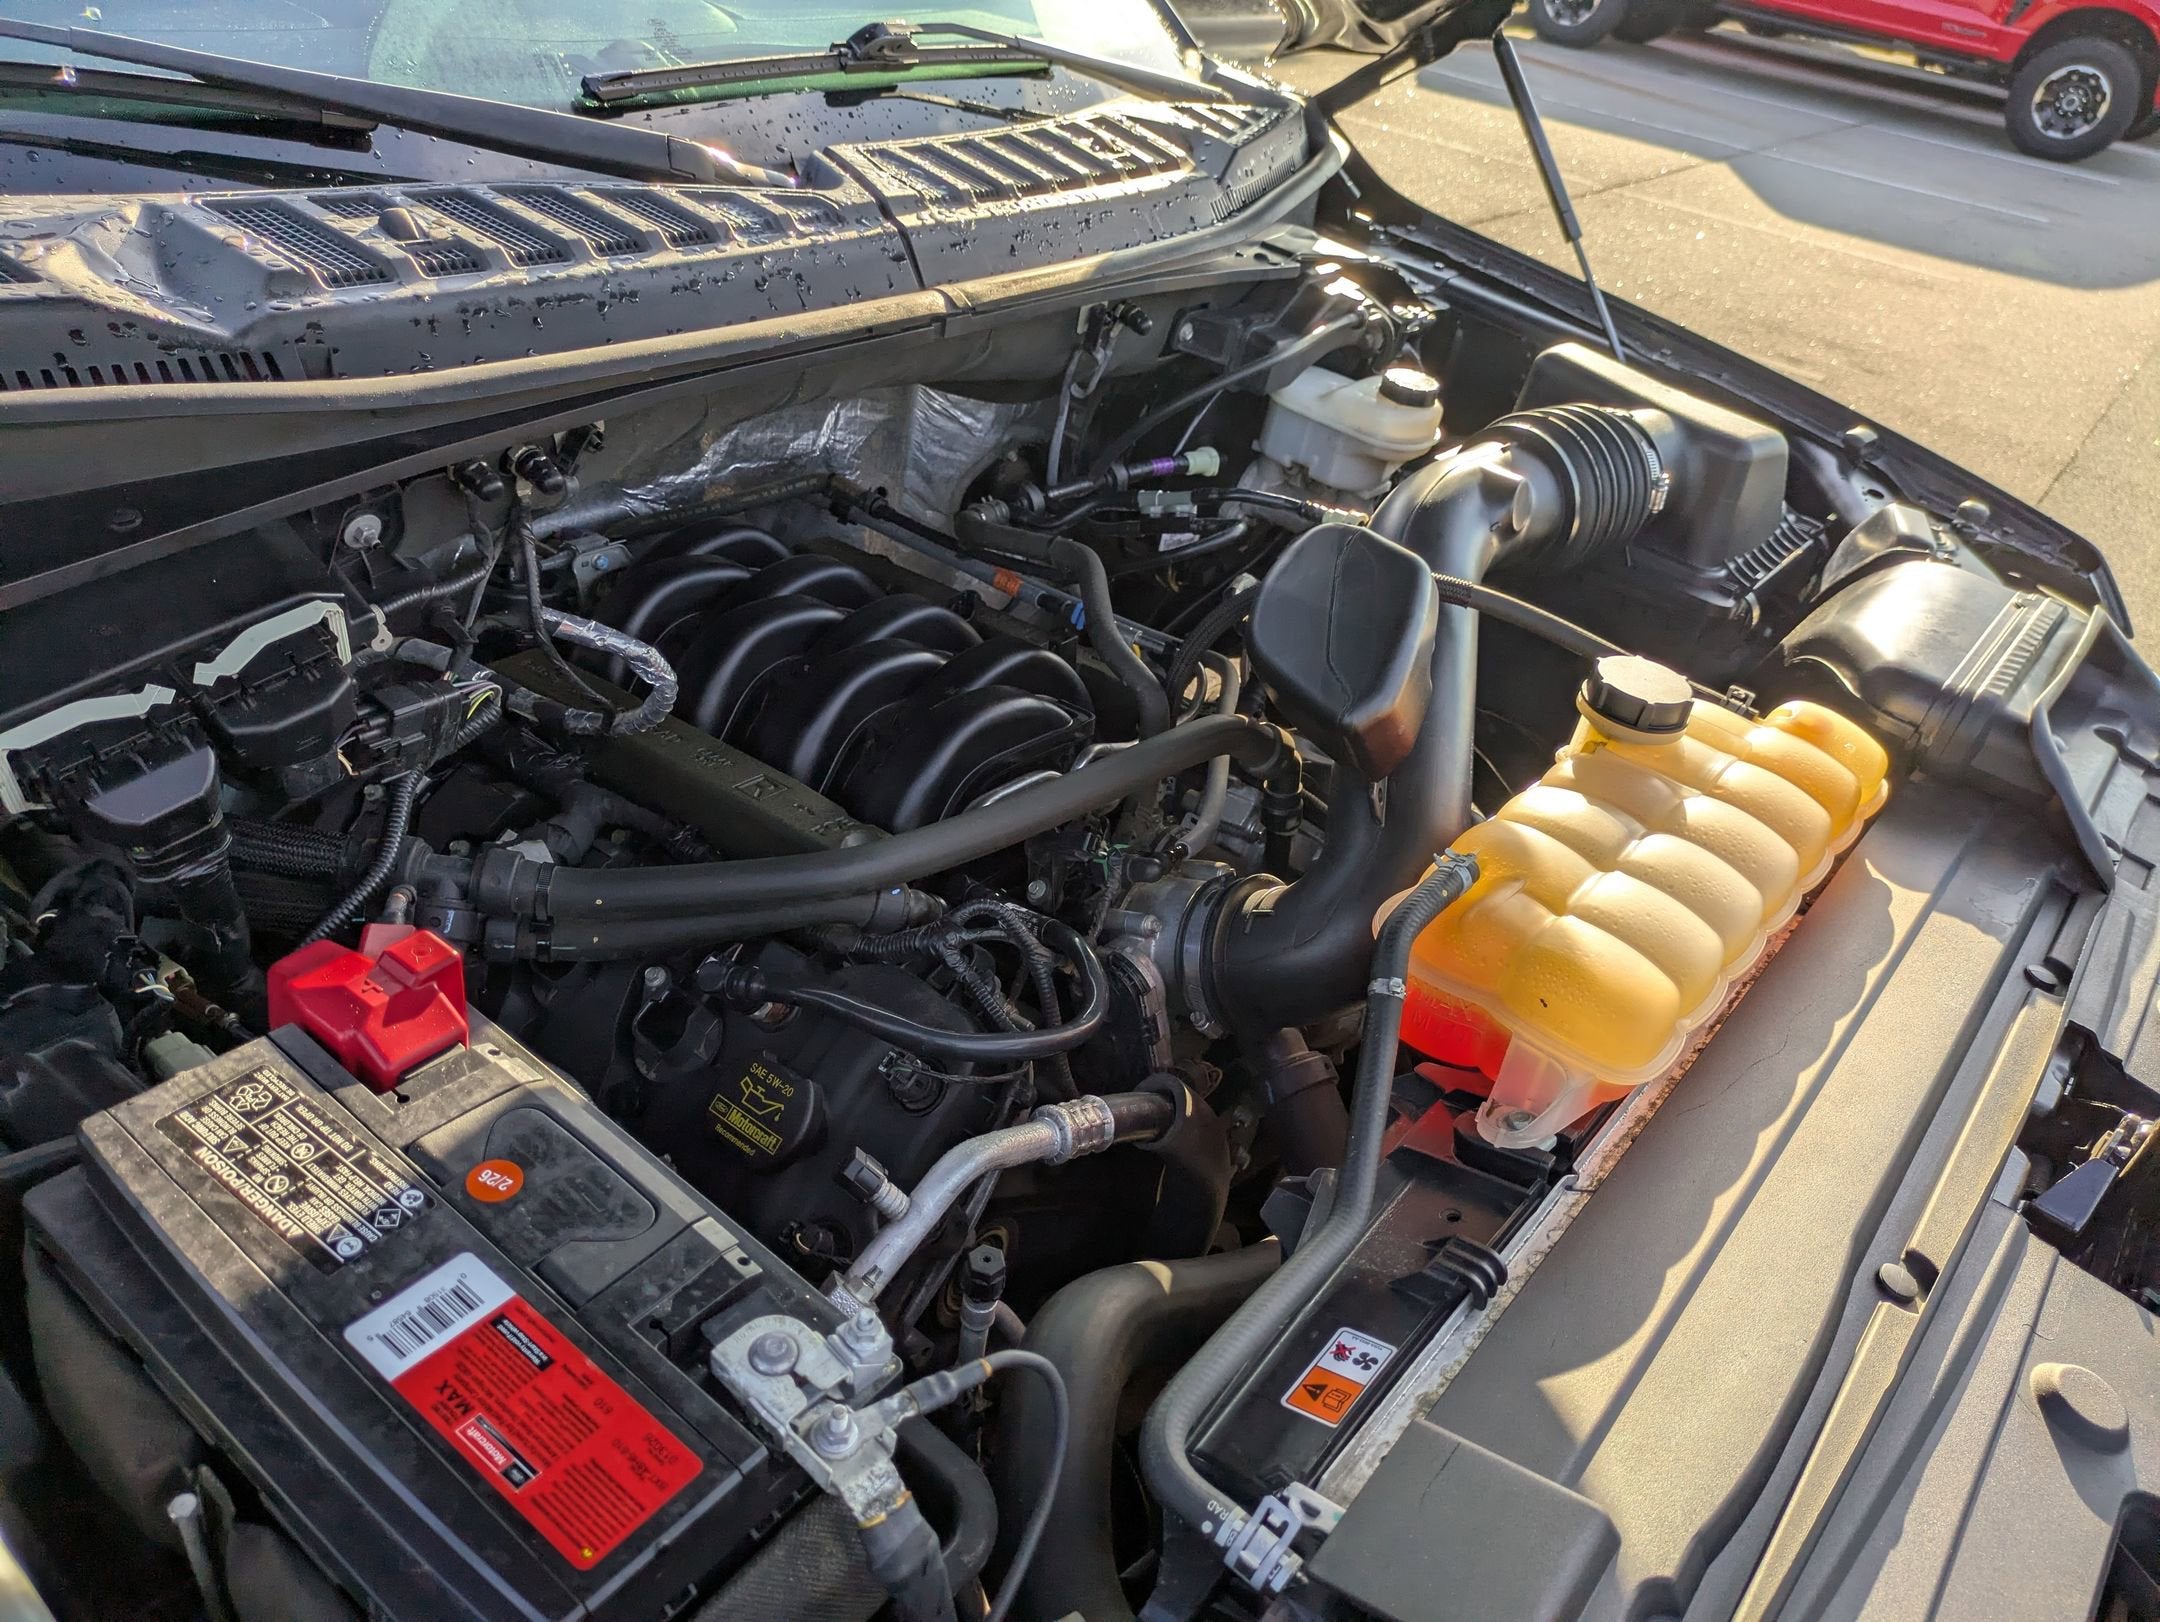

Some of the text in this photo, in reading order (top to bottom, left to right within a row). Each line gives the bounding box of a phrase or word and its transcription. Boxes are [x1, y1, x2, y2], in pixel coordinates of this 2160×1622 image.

[750, 1062, 794, 1097] SAE 5W-20
[265, 1082, 290, 1101] BATTERY
[283, 1087, 296, 1096] BE
[177, 1110, 222, 1144] SULFURIC ACID
[198, 1115, 230, 1139] CAN CAUSE
[199, 1105, 238, 1134] BLINDNESS OR
[223, 1113, 246, 1129] SEVERE
[309, 1117, 324, 1127] OR
[318, 1124, 334, 1135] TIP
[728, 1109, 777, 1151] Motorcraft
[257, 1121, 293, 1149] KEEP OUT OF
[268, 1120, 300, 1144] THE REACH
[295, 1131, 308, 1139] OF
[327, 1131, 346, 1144] NOT
[715, 1124, 756, 1156] Recommended
[339, 1141, 355, 1152] DO
[192, 1145, 294, 1230] DANGER/POISON
[250, 1172, 266, 1183] NO
[331, 1172, 347, 1183] GET
[347, 1173, 366, 1187] HELP
[382, 1180, 402, 1195] READ
[477, 1169, 514, 1191] 2/26
[304, 1161, 372, 1216] FLUSH EYES IMMEDIATELY
[360, 1184, 387, 1205] MEDICAL
[308, 1196, 341, 1223] GASES CAN
[322, 1196, 335, 1206] OR
[360, 1196, 379, 1210] WITH
[296, 1200, 334, 1228] EXPLOSIVE
[298, 1214, 325, 1234] SHIELD
[329, 1203, 362, 1228] BLINDNESS
[355, 1225, 378, 1242] CAUSE
[496, 1323, 509, 1334] used
[501, 1318, 521, 1335] vehicle
[516, 1331, 542, 1354] Start-Stop
[517, 1342, 542, 1365] Warranty
[433, 1379, 475, 1416] MAX
[464, 1424, 508, 1465] Motorcraft
[1206, 1499, 1230, 1521] RAD
